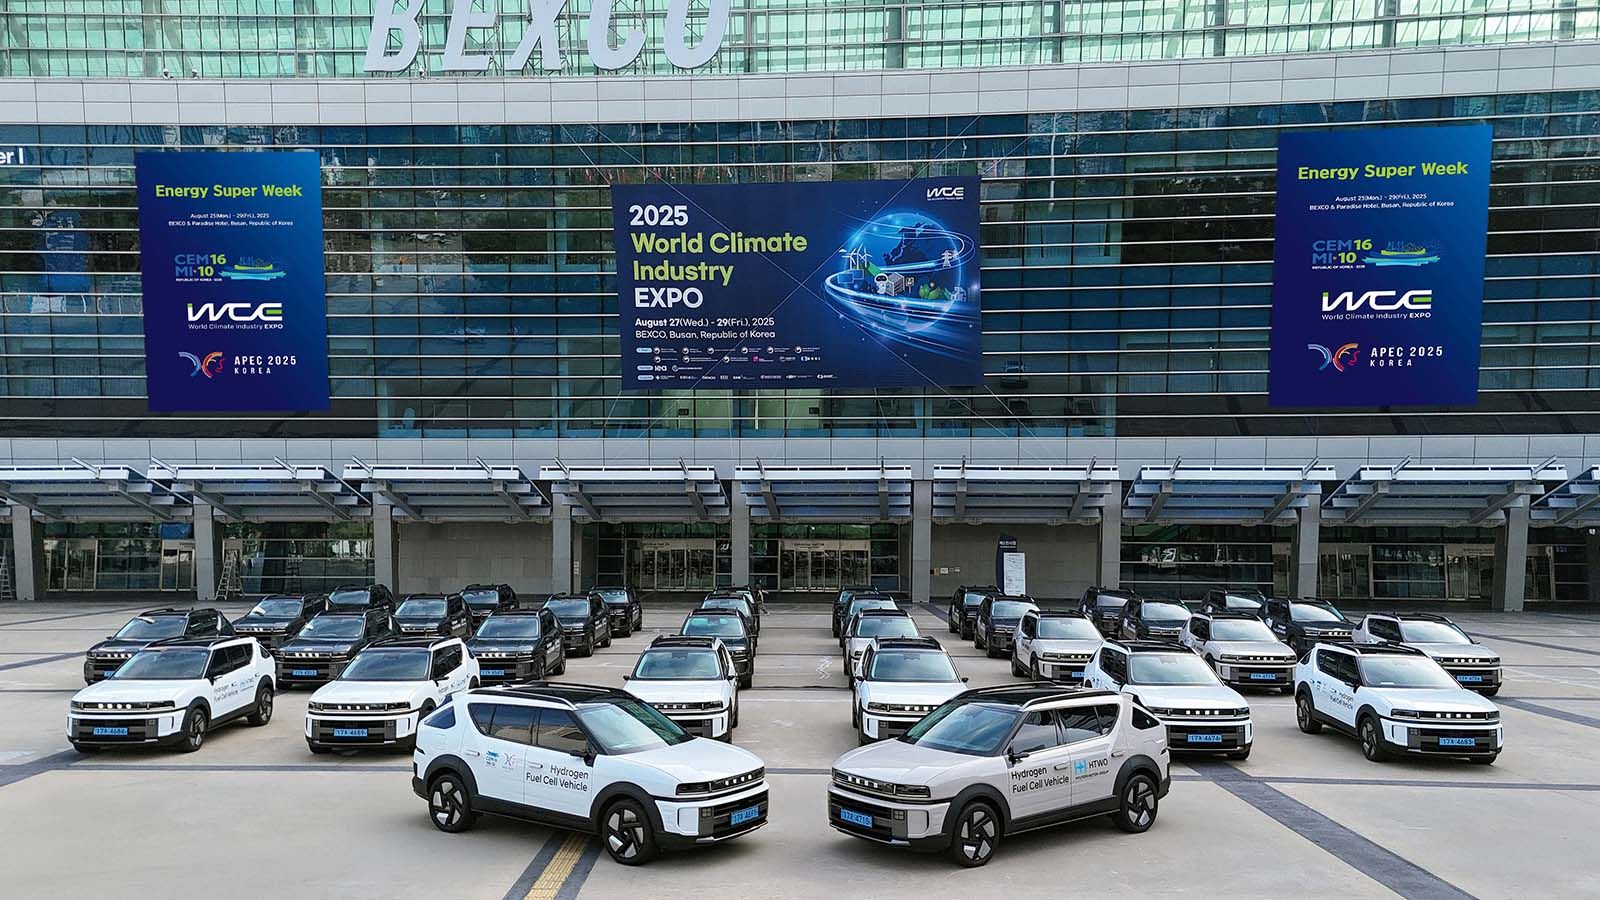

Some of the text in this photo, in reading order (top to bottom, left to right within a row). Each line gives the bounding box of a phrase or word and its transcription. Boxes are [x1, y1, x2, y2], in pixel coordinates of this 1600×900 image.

[1298, 161, 1468, 181] Energy Super Week
[155, 184, 302, 199] Energy Super Week
[629, 204, 689, 226] 2025
[630, 231, 808, 254] World Climate
[633, 260, 734, 286] Industry
[634, 287, 704, 308] EXPO
[635, 318, 668, 328] August
[669, 318, 709, 327] 27(Wed.)
[752, 317, 775, 326] 2025
[635, 330, 775, 340] BEXCO, Busan, Republic of Korea
[1371, 346, 1443, 357] APEC 2025
[234, 356, 296, 365] APEC 2025
[1370, 359, 1412, 367] KOREA
[1088, 758, 1108, 769] HTWO
[550, 765, 589, 780] Hydrogen
[1011, 767, 1047, 780] Hydrogen
[526, 772, 588, 792] Fuel Cell Vehicle
[1012, 775, 1069, 793] Fuel Cell Vehicle
